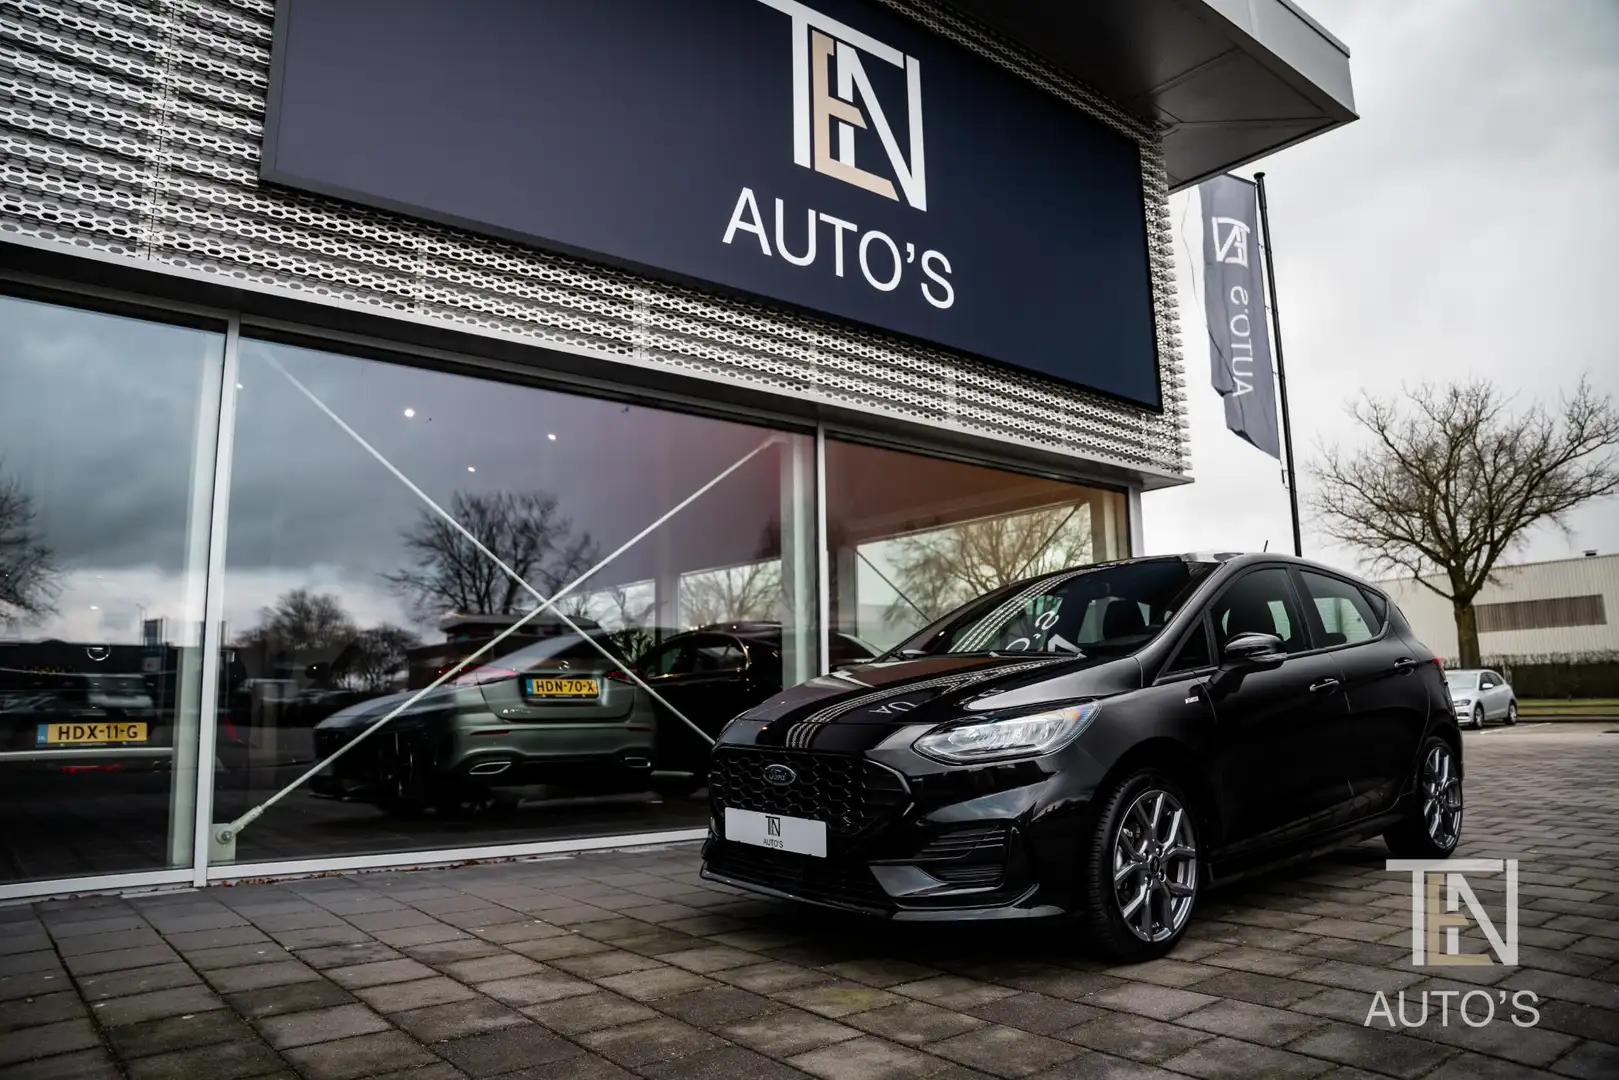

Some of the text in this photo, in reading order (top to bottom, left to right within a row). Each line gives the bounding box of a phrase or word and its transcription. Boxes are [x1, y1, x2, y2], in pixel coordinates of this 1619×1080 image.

[722, 187, 955, 309] AUTO'S
[536, 680, 595, 693] HDN-70-X
[58, 725, 138, 741] HDX-11-G
